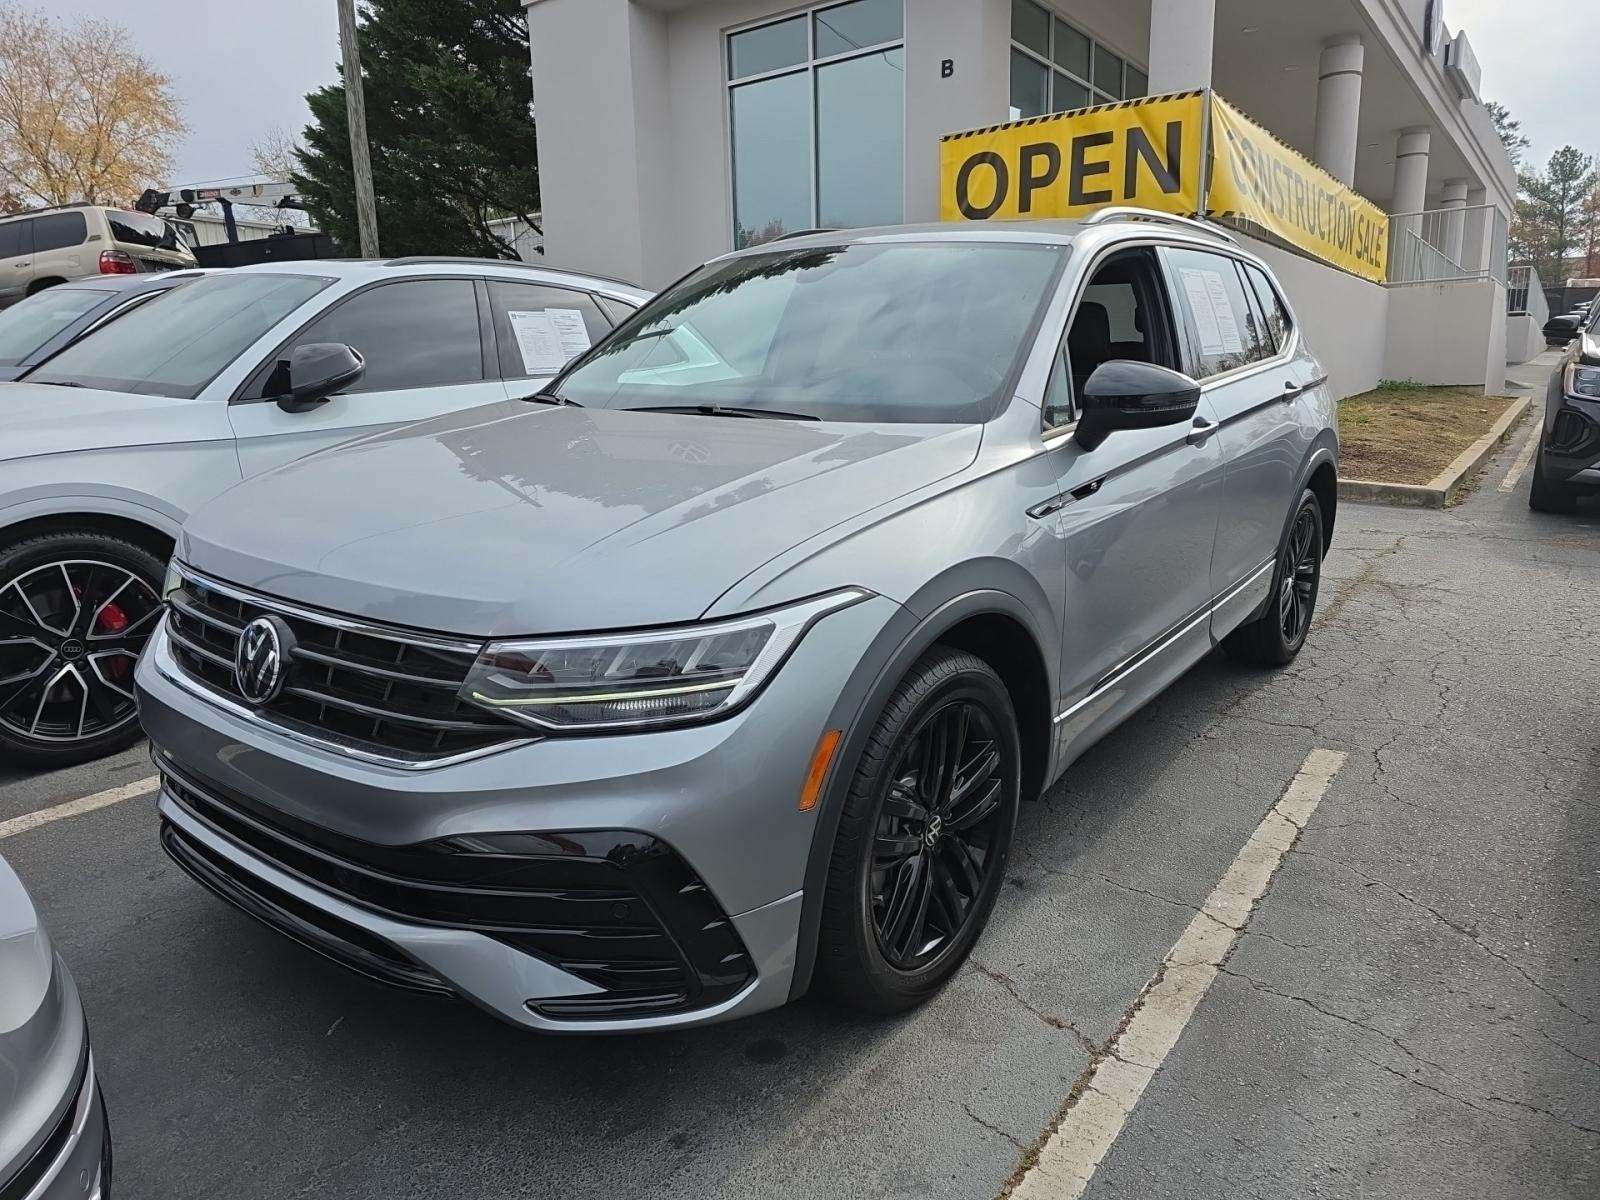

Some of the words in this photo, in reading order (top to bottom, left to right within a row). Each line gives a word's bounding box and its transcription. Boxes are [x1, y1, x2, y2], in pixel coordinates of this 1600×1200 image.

[941, 58, 954, 78] B
[955, 121, 1182, 220] OPEN
[1226, 129, 1357, 255] CONSTRUCTION
[1356, 214, 1384, 268] SALE
